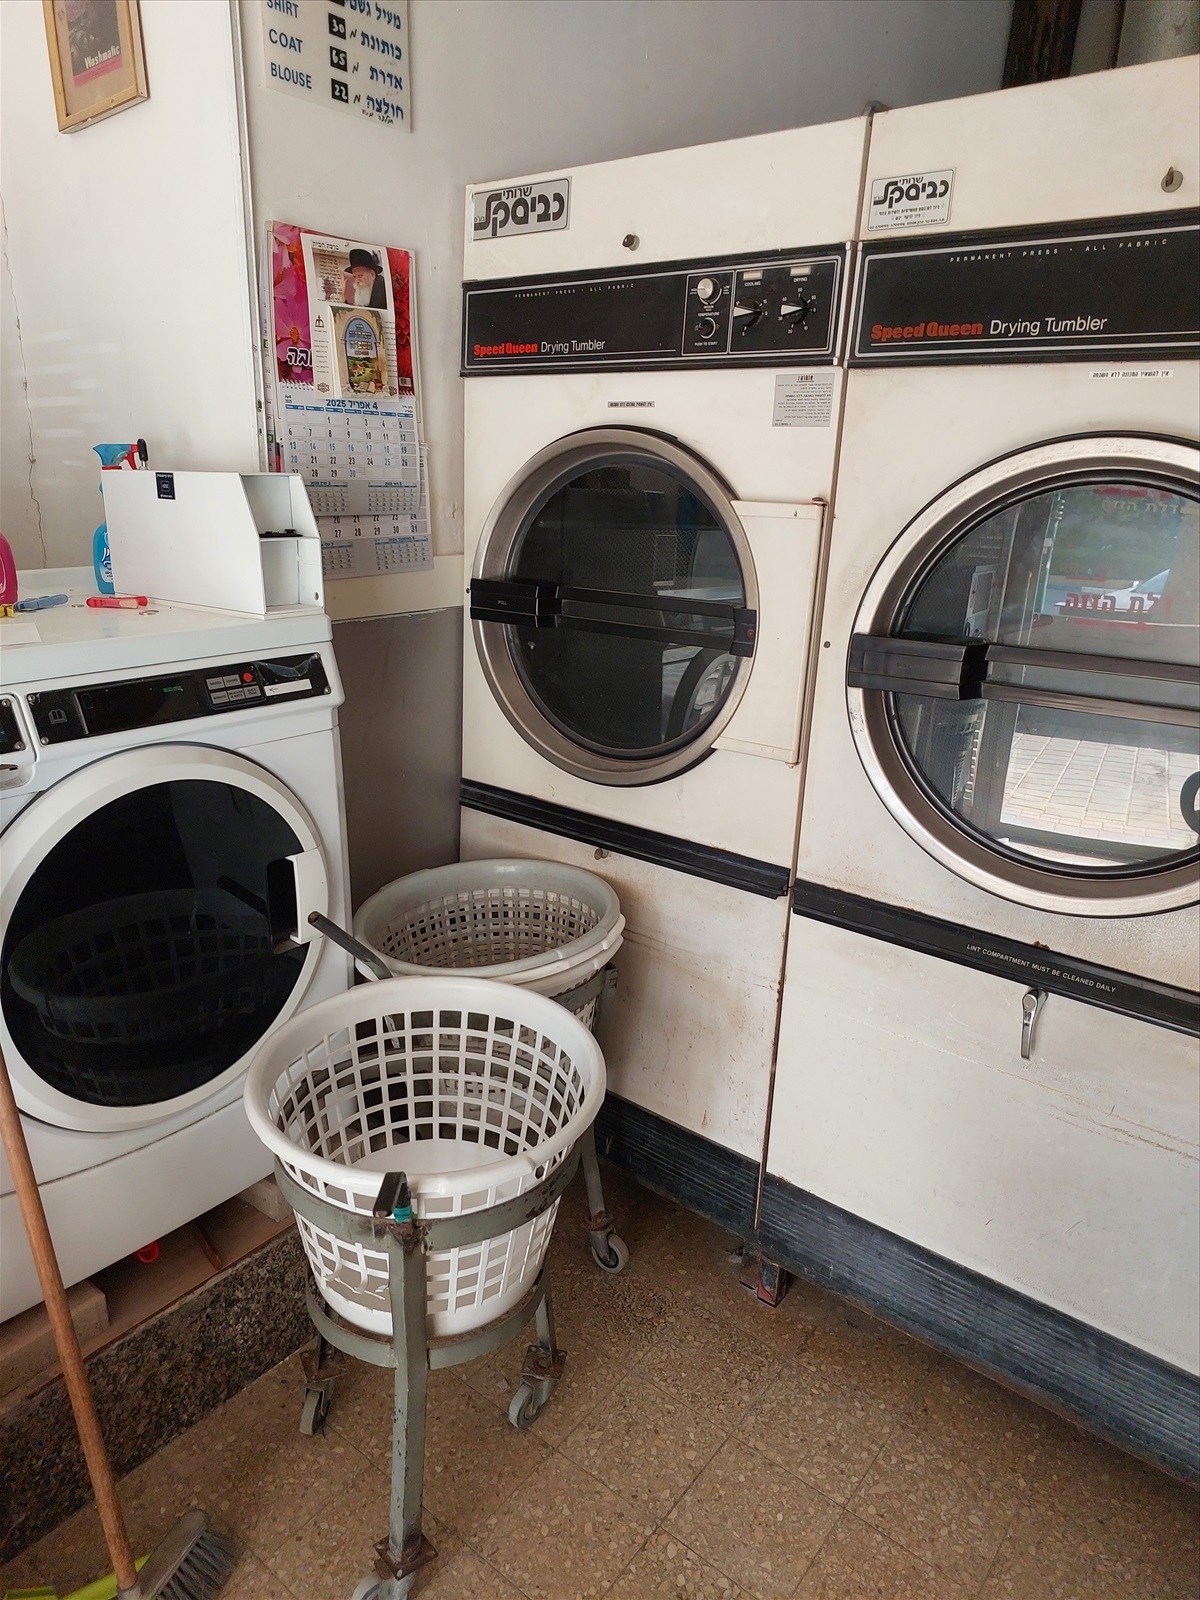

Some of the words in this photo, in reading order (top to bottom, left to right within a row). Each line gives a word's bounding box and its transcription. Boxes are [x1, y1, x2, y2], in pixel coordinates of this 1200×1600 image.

[332, 19, 344, 33] 30
[376, 2, 401, 29] מעיל
[269, 29, 303, 53] COAT
[361, 31, 401, 60] כותונת
[84, 45, 120, 69] Washmatic
[332, 50, 346, 66] 65
[270, 62, 312, 89] BLOUSE
[370, 66, 403, 90] אדרת
[334, 85, 347, 99] 22
[367, 95, 403, 120] חולצה
[899, 176, 924, 185] שרותי
[503, 186, 532, 200] שרותי
[950, 252, 1013, 262] PERMANENT
[1022, 249, 1058, 257] PRESS
[1119, 239, 1168, 248] FABRIC
[871, 322, 925, 342] Speed
[926, 320, 984, 338] Queen
[989, 319, 1040, 338] Drying
[1044, 315, 1108, 333] Tumbler
[474, 343, 505, 357] Speed
[505, 342, 538, 354] Queen
[541, 341, 568, 354] Drying
[571, 339, 606, 352] Tumbler
[349, 400, 371, 410] אפריל
[966, 943, 981, 952] LINT
[982, 948, 1031, 967] COMPARTMENT
[1031, 963, 1050, 974] MUST
[1062, 972, 1094, 987] CLEANED
[1096, 982, 1116, 993] DAILY
